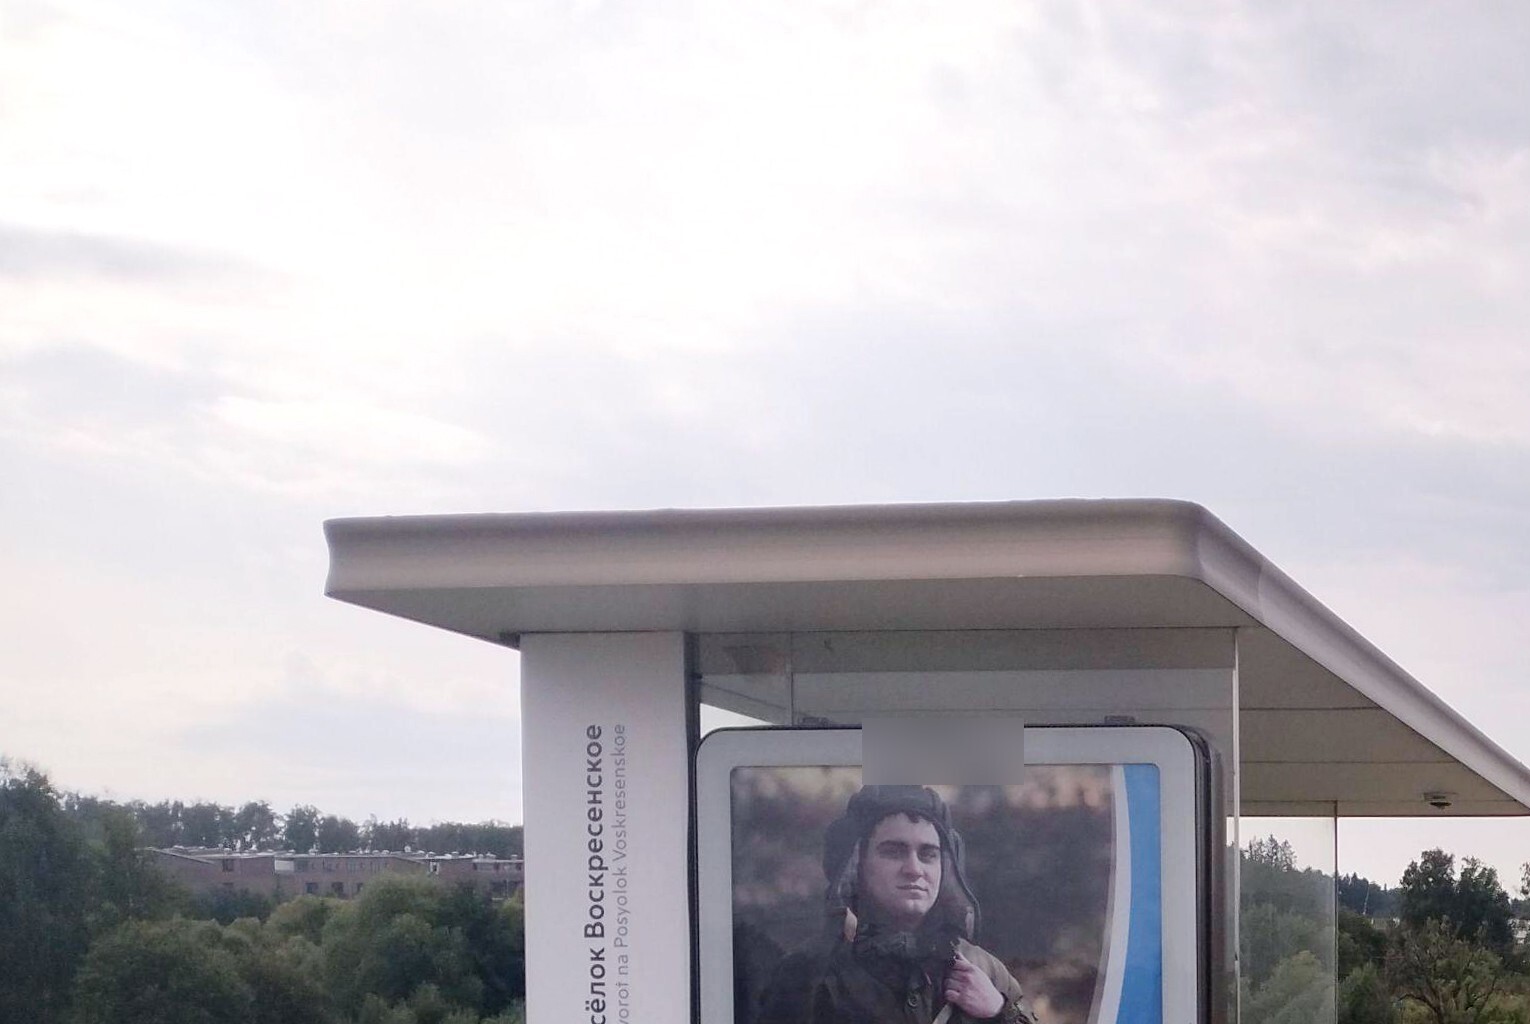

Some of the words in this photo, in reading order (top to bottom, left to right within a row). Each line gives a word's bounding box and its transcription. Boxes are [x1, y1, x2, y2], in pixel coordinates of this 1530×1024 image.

[584, 724, 609, 938] Воскресенское
[610, 724, 628, 862] Voskresenskoe
[611, 867, 631, 948] Posyolok
[617, 954, 629, 976] na
